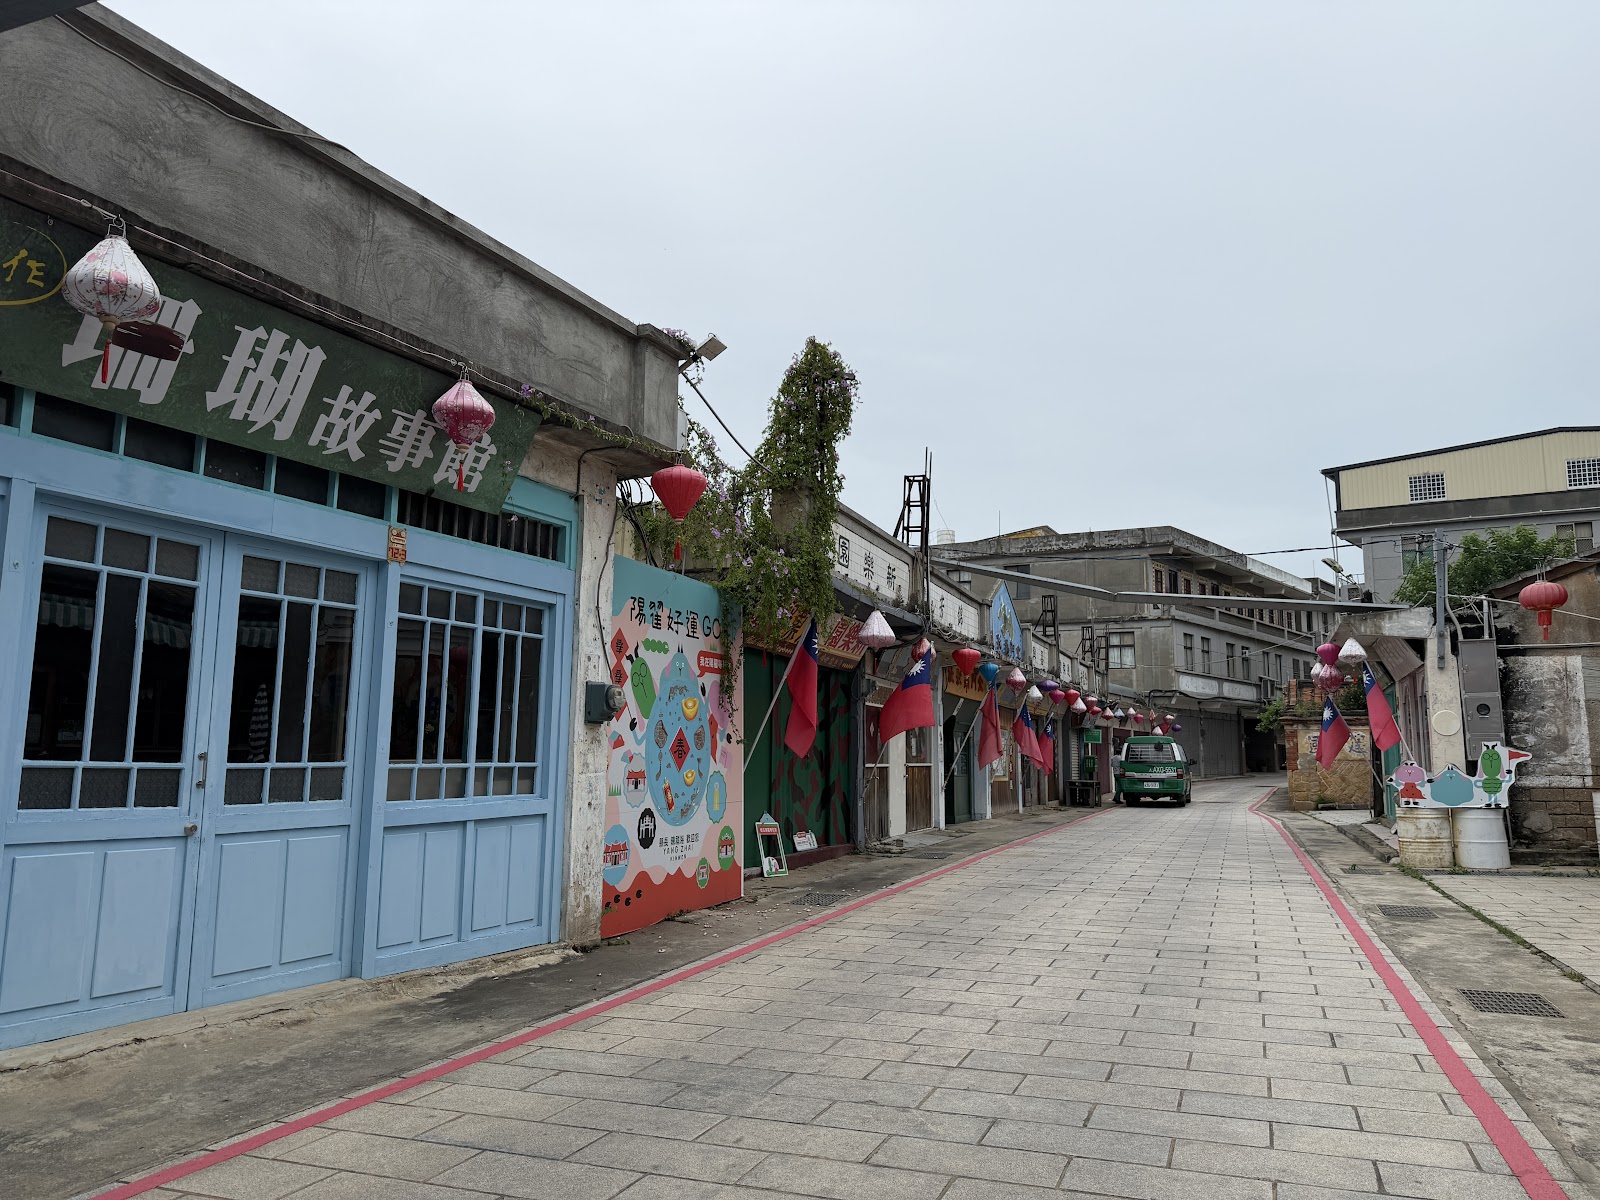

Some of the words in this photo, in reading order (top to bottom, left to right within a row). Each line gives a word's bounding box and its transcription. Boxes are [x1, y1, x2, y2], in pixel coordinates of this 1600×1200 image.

[674, 738, 686, 758] 春
[662, 845, 679, 855] YANG
[680, 844, 694, 853] ZHAI
